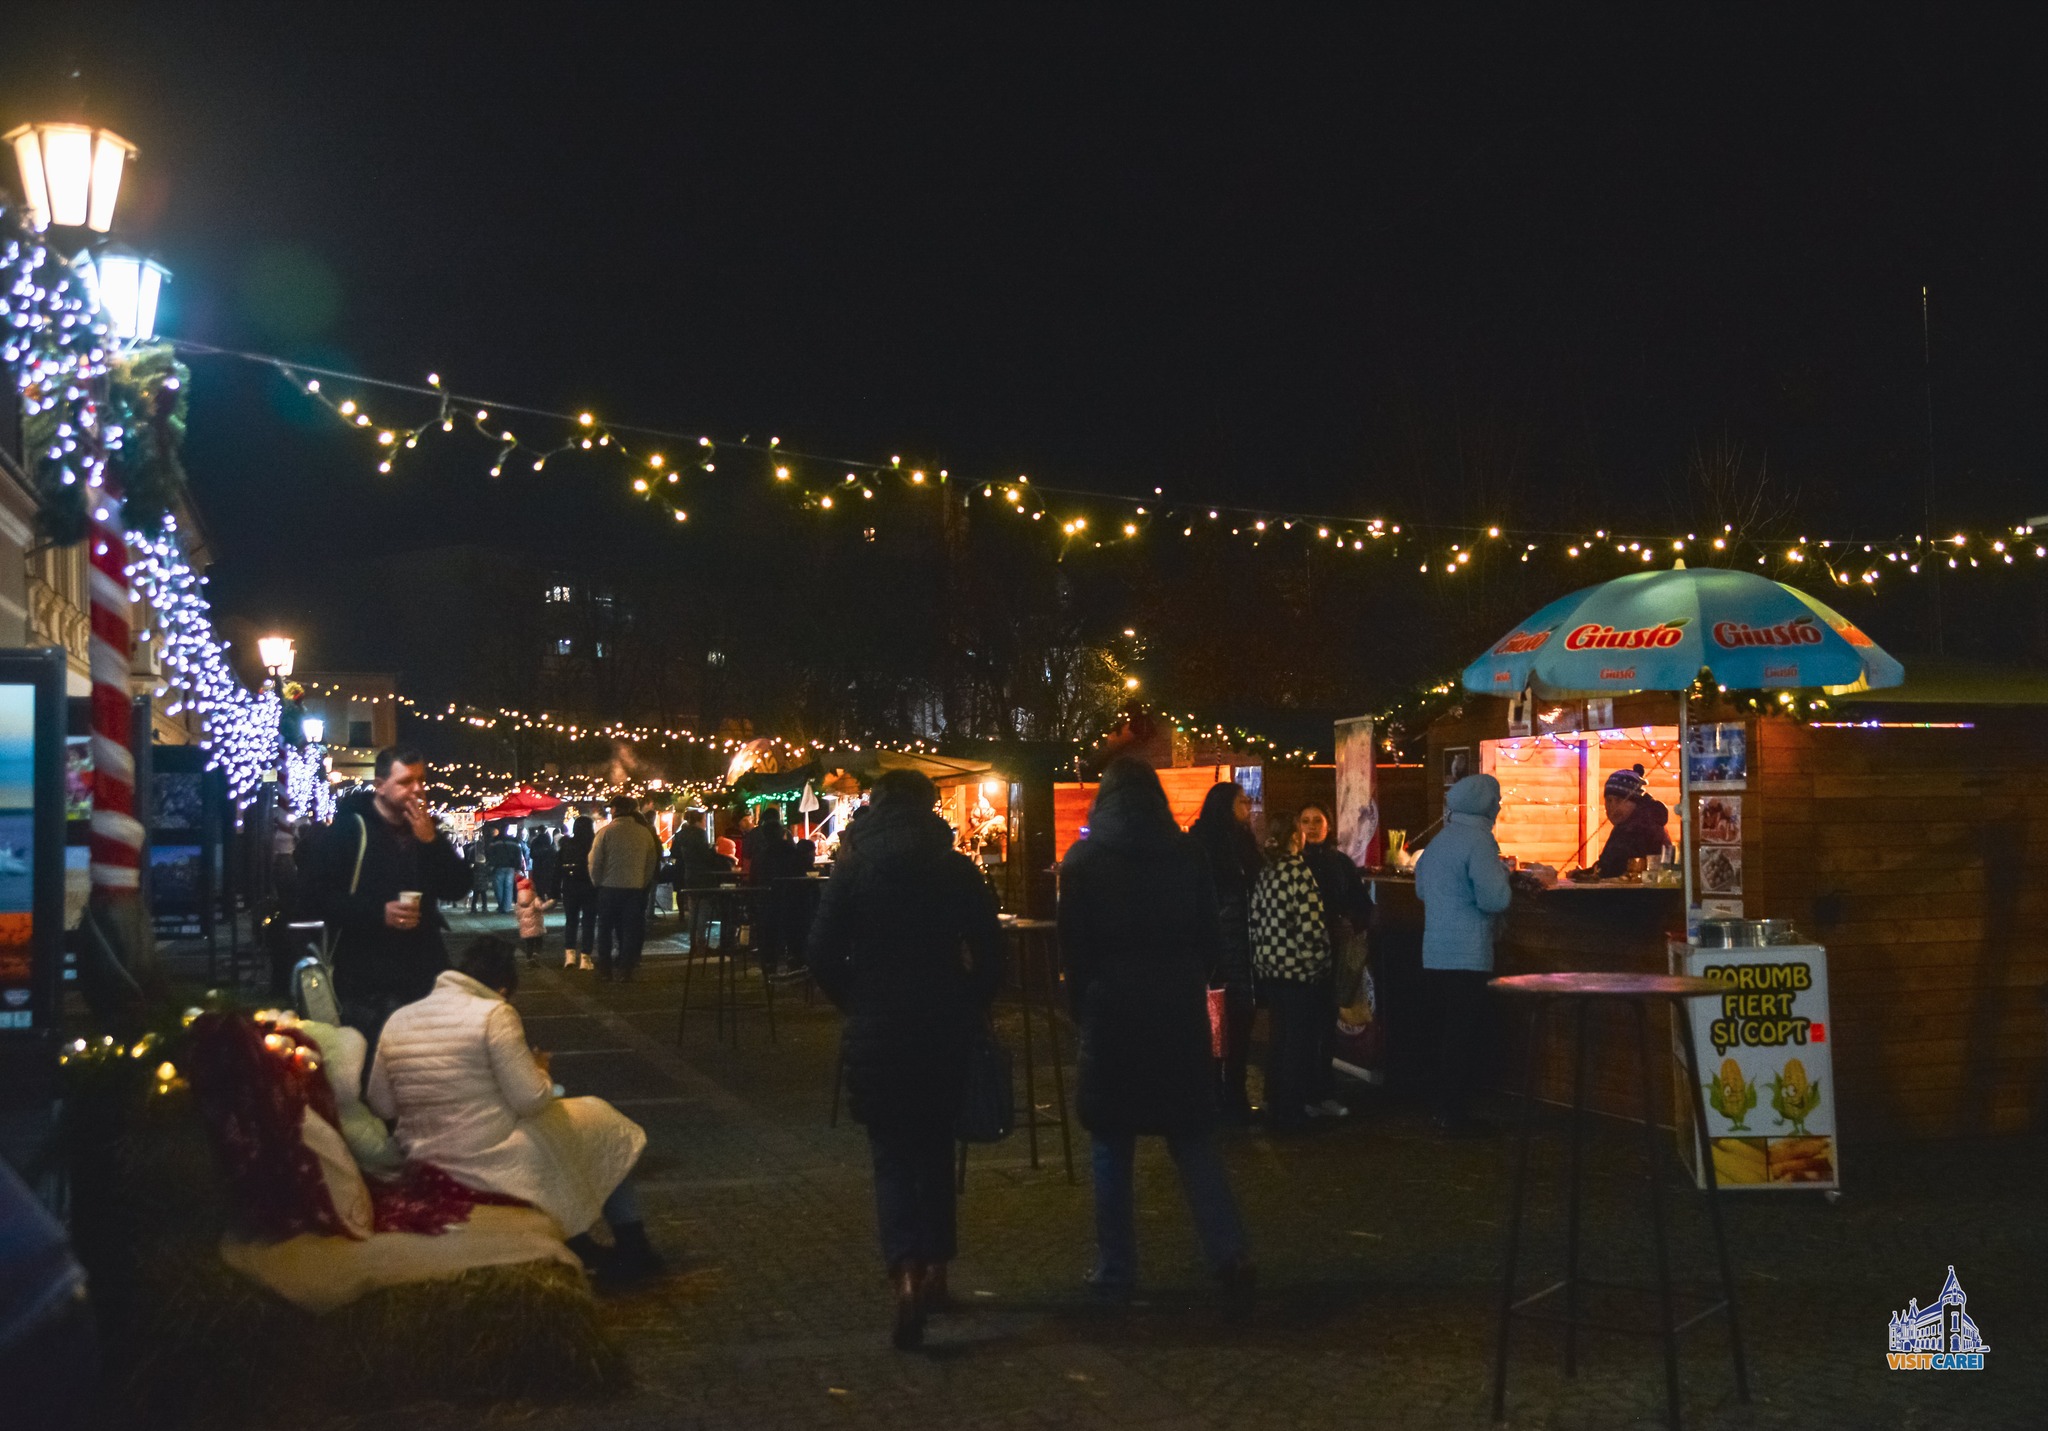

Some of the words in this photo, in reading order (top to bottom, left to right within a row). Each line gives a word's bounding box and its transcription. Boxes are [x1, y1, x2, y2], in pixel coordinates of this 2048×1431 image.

[1566, 622, 1683, 650] Giusto
[1713, 619, 1822, 648] Giusto
[1723, 992, 1796, 1018] FIERT
[1742, 1018, 1810, 1046] COPT
